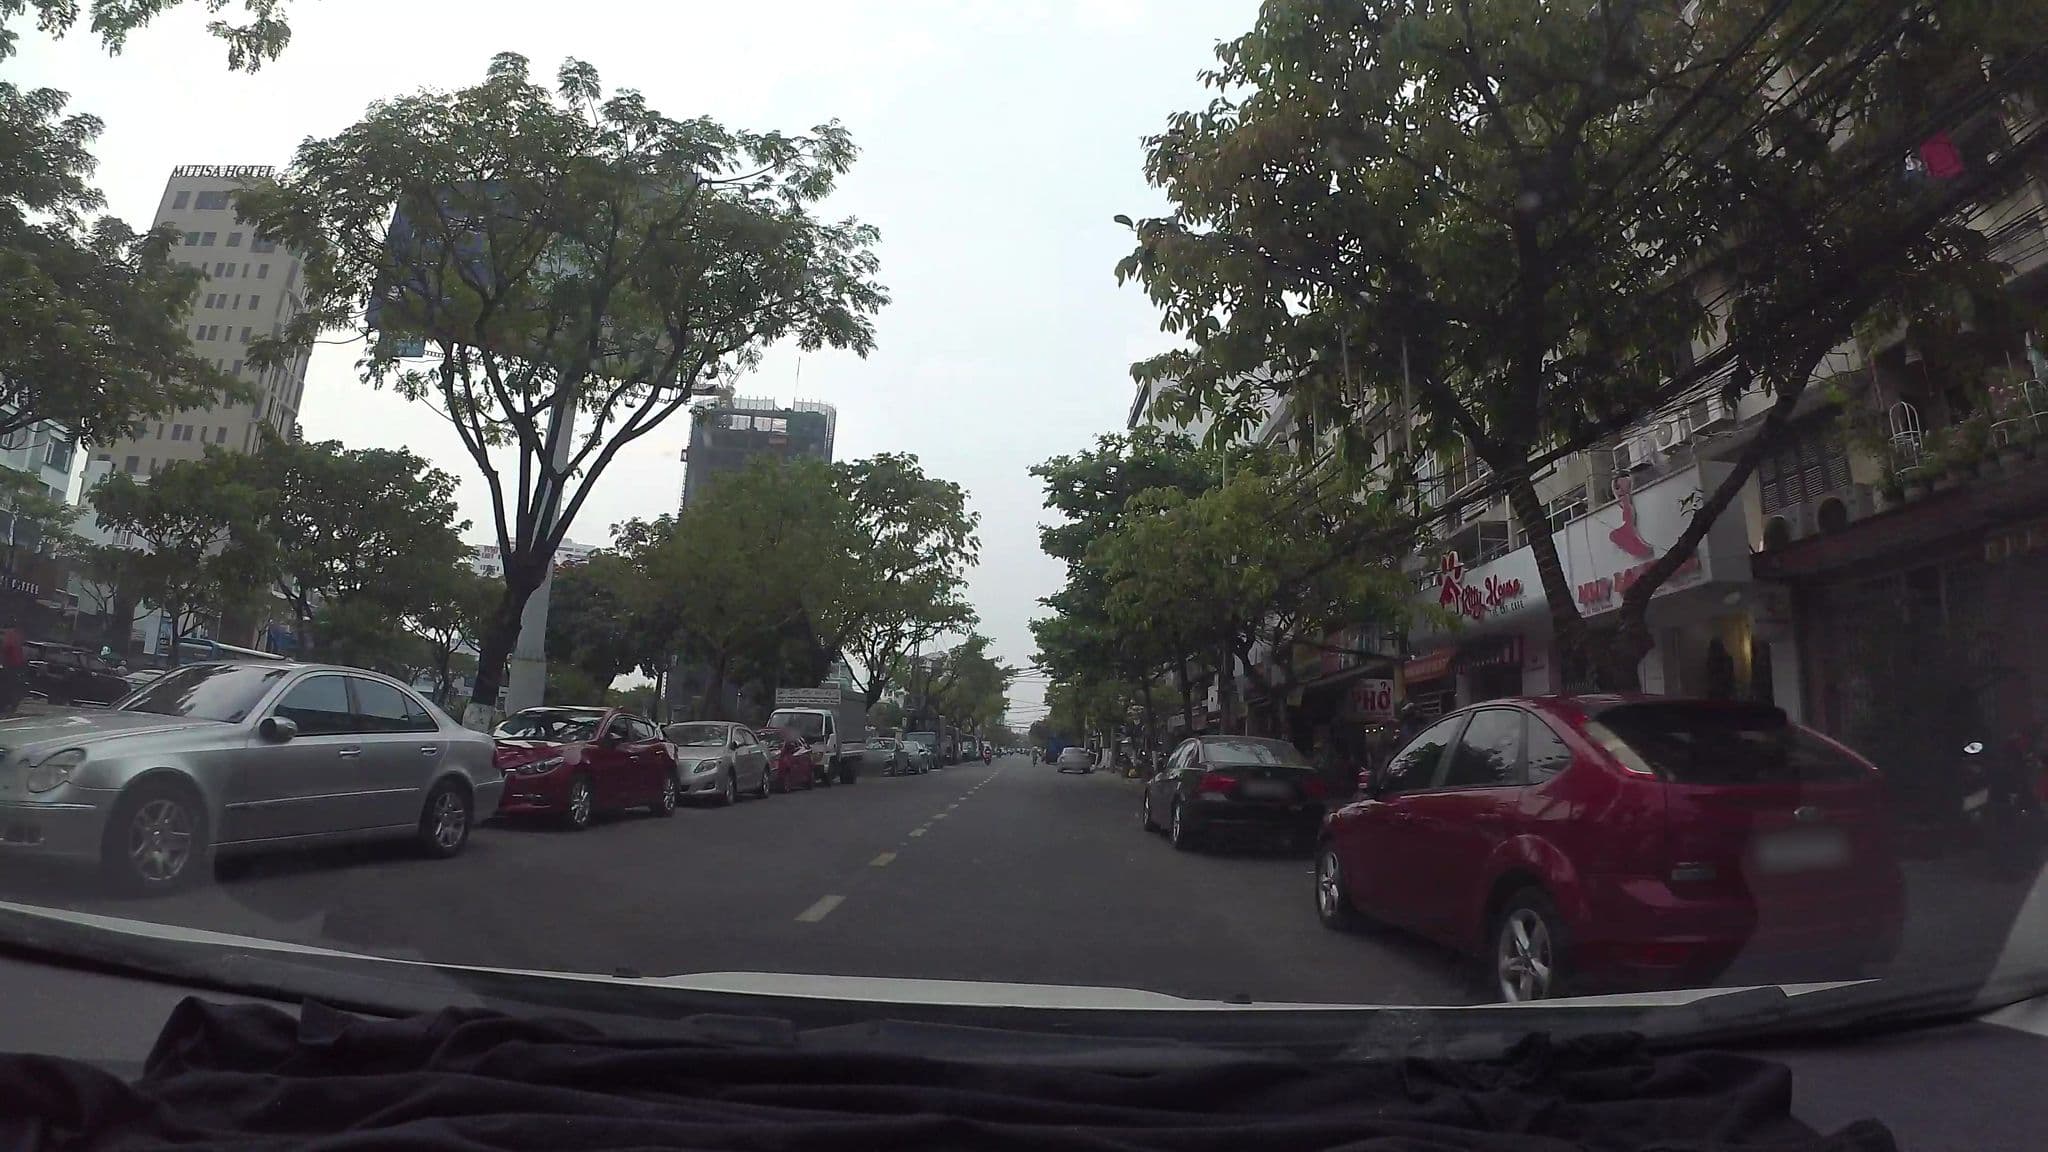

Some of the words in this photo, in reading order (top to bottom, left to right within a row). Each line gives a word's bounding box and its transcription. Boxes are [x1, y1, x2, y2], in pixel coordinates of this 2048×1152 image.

[172, 165, 222, 178] MITISA
[1485, 574, 1521, 607] House
[1352, 681, 1391, 711] PHỞ
